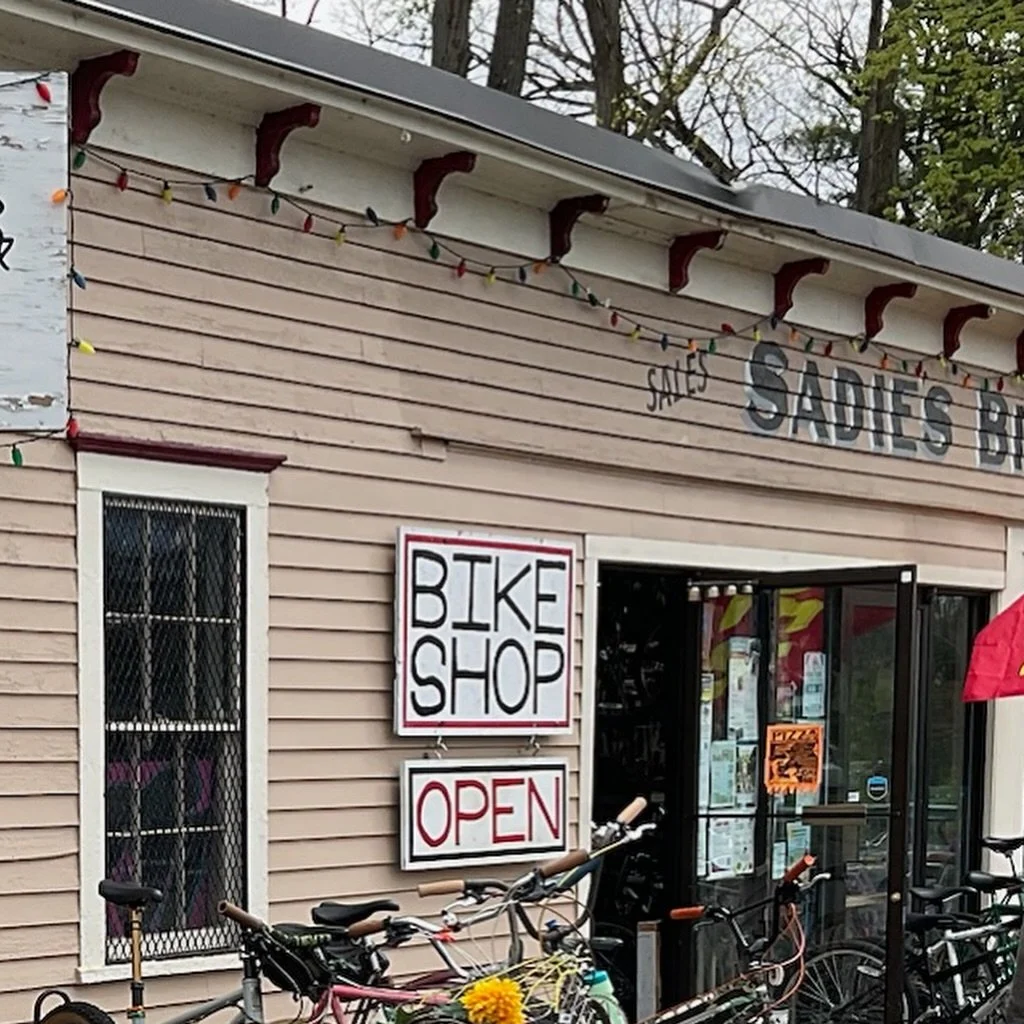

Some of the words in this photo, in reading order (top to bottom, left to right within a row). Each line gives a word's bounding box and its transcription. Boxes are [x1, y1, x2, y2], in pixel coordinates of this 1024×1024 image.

[647, 352, 708, 412] SALES
[411, 548, 566, 635] BIKE
[410, 634, 565, 717] SHOP
[772, 729, 817, 742] PIZZA
[416, 776, 560, 847] OPEN
